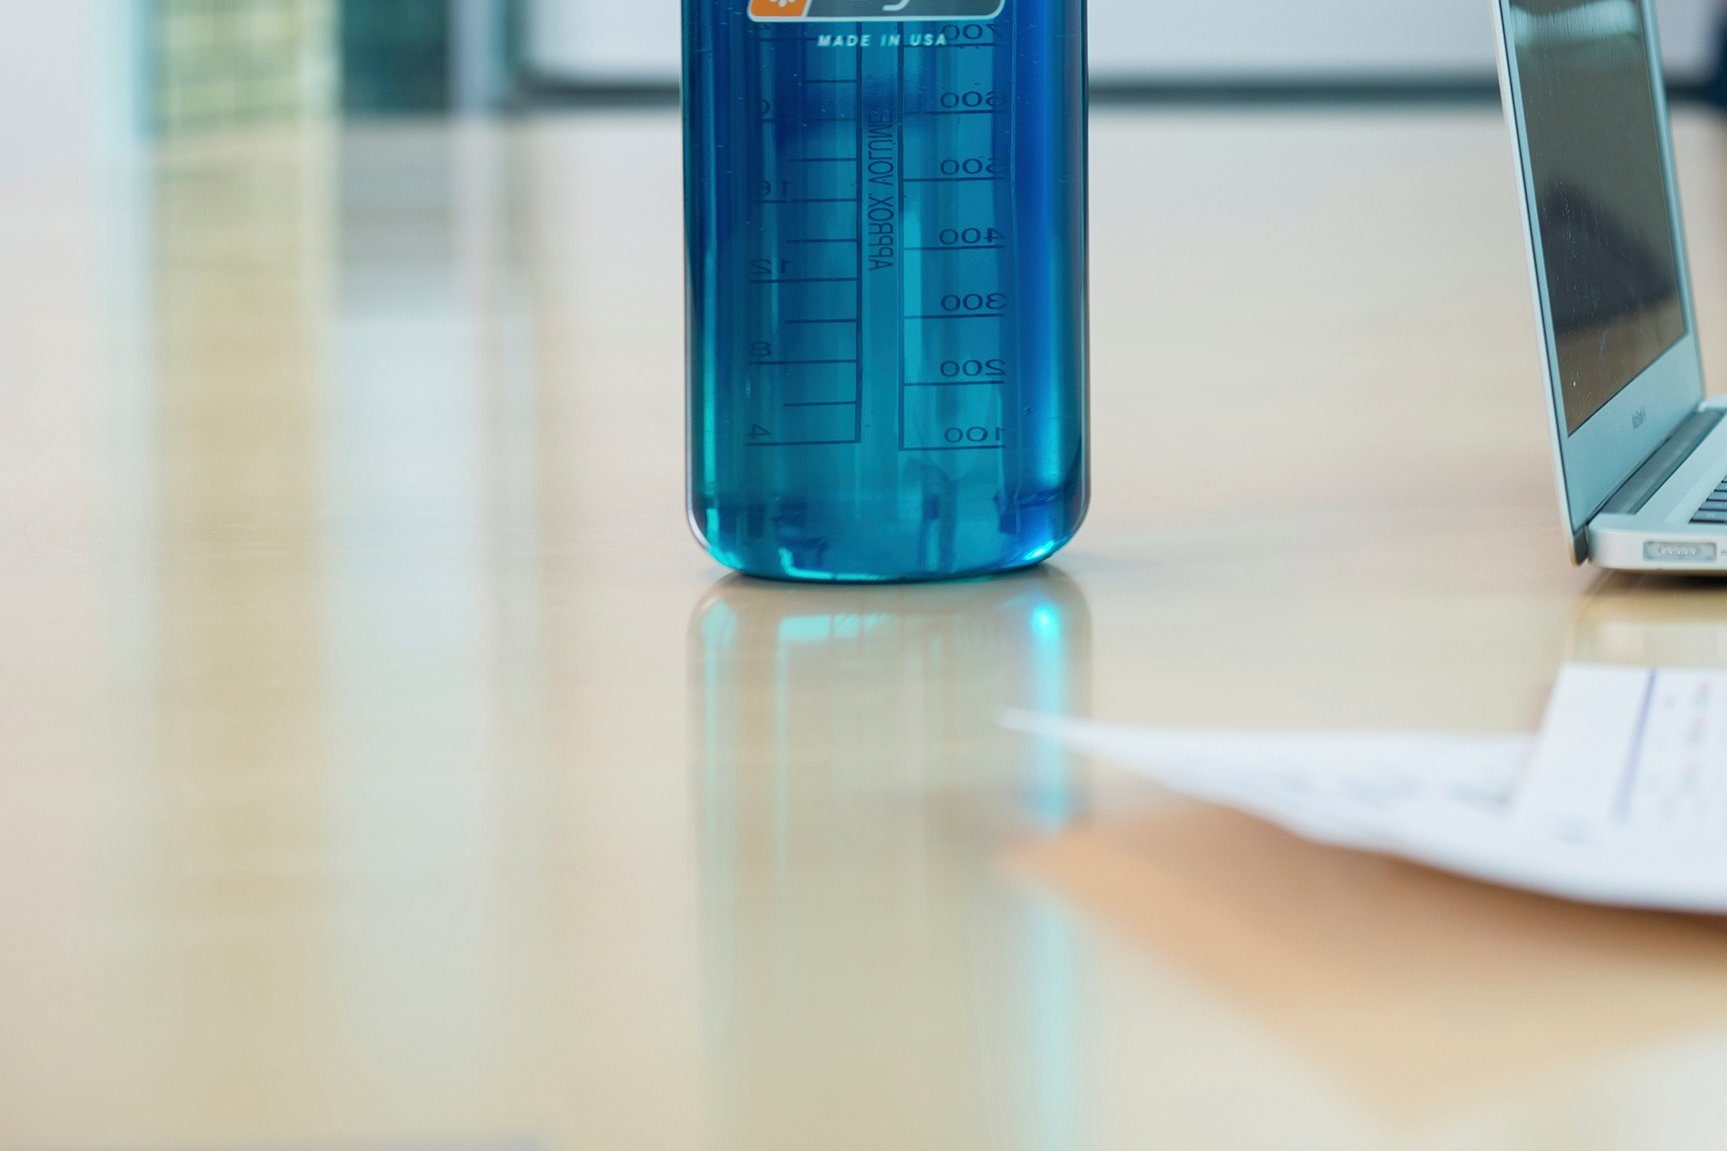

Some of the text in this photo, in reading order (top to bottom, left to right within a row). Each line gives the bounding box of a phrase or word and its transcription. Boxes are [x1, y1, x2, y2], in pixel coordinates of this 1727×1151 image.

[817, 33, 947, 47] MADE IN USA
